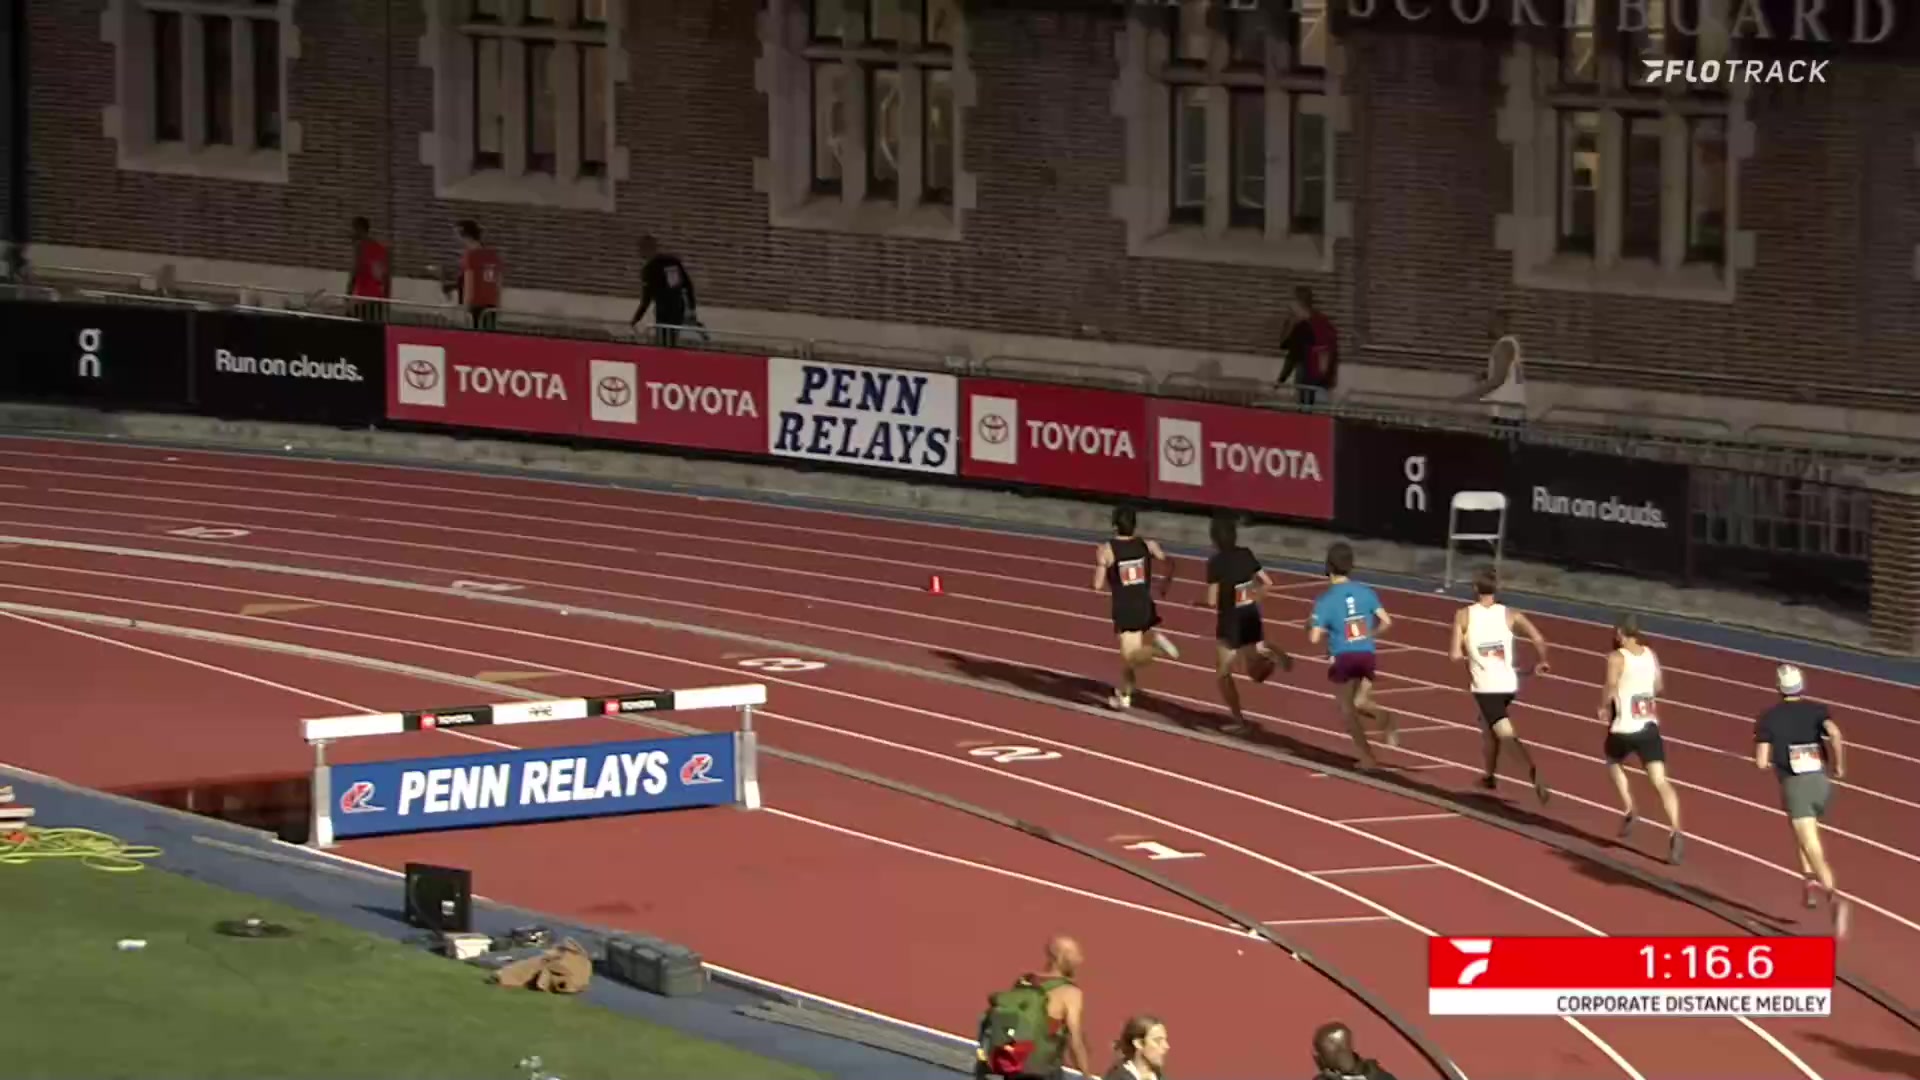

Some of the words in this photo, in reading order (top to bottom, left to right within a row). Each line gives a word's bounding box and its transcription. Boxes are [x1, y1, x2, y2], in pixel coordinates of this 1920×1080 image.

[215, 349, 257, 373] Run
[259, 357, 286, 376] on
[289, 355, 364, 381] clouds.
[453, 365, 568, 401] TOYOTA
[645, 382, 759, 418] TOYOTA
[796, 366, 928, 416] PENN
[774, 411, 951, 467] RELAYS
[1026, 420, 1136, 459] TOYOTA
[1210, 441, 1323, 482] TOYOTA
[1532, 486, 1569, 514] Run
[1571, 499, 1598, 519] on
[1599, 496, 1668, 529] clouds.
[967, 744, 1063, 763] 2
[397, 763, 511, 816] PENN
[519, 749, 669, 804] RELAYS
[1122, 840, 1207, 861] 1
